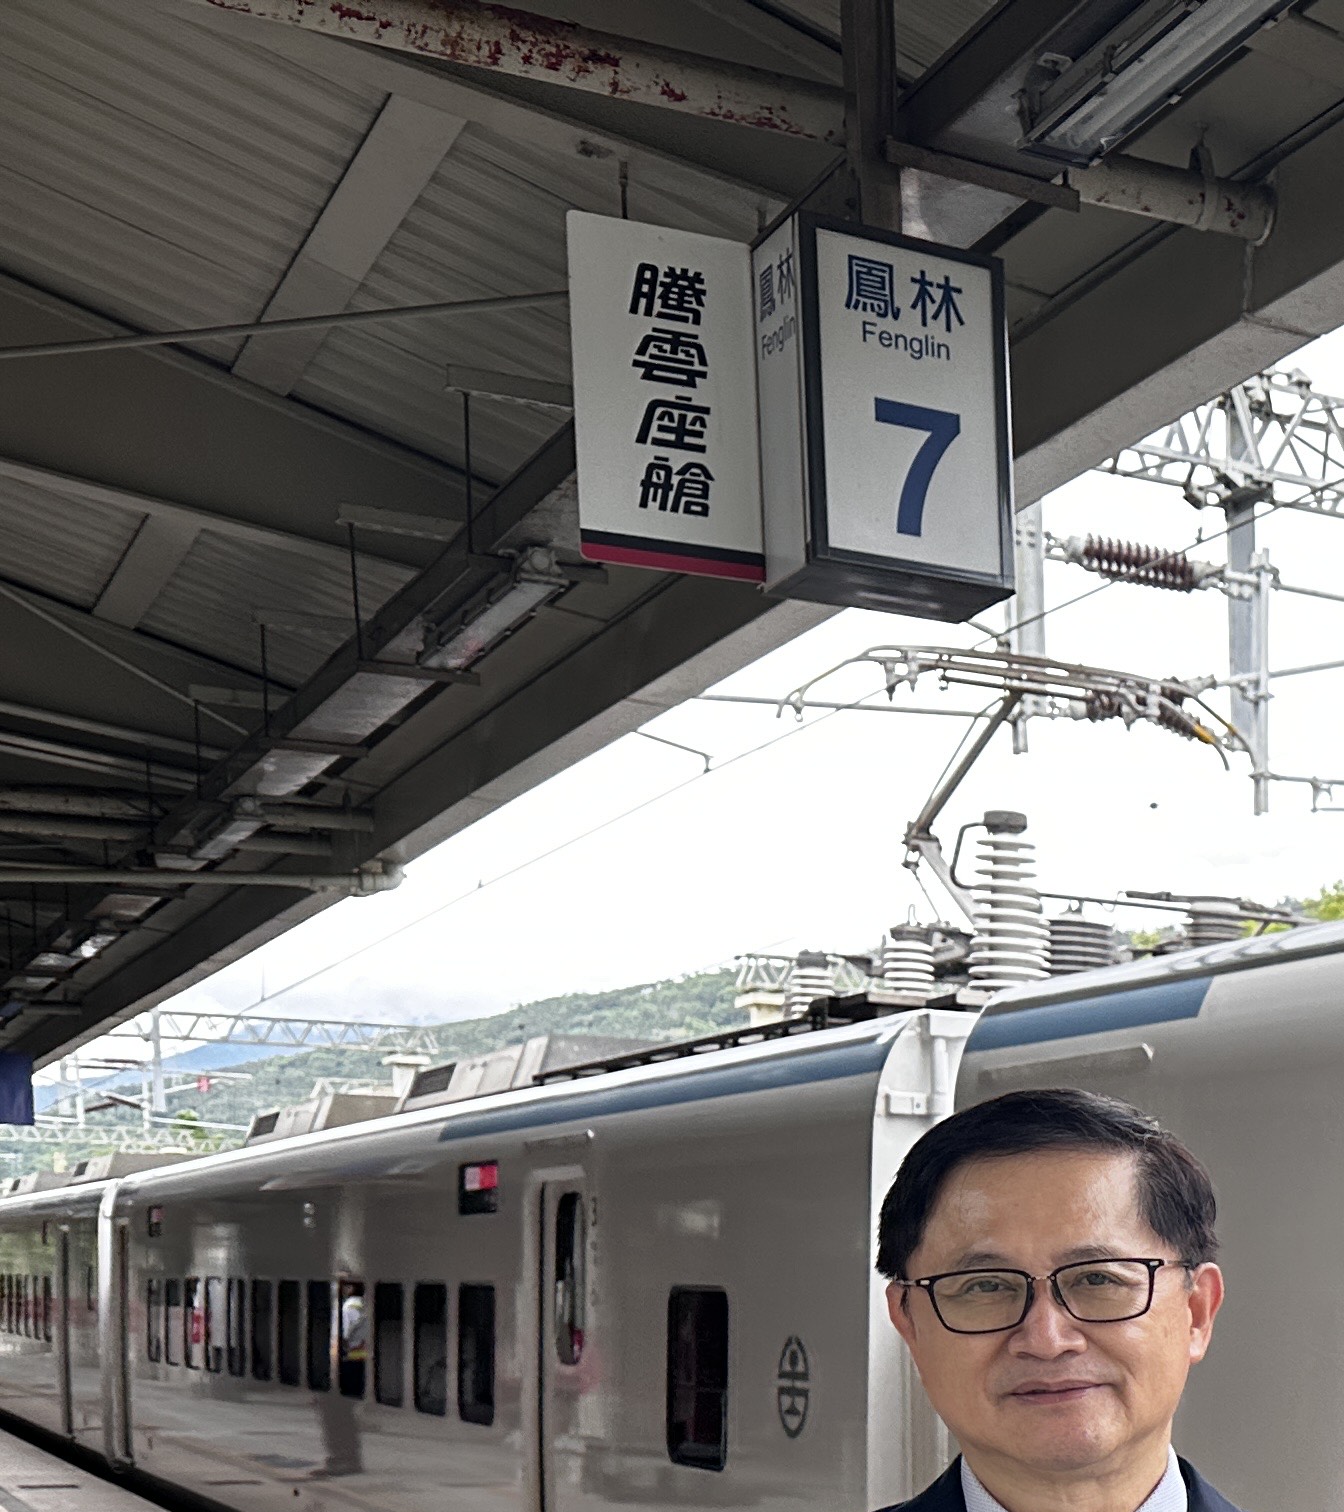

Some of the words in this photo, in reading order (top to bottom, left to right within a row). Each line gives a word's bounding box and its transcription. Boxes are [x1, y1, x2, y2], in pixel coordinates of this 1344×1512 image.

[845, 253, 965, 333] 鳳林
[861, 321, 951, 361] Fenglin
[628, 261, 715, 518] 騰雲座艙
[874, 396, 961, 538] 7
